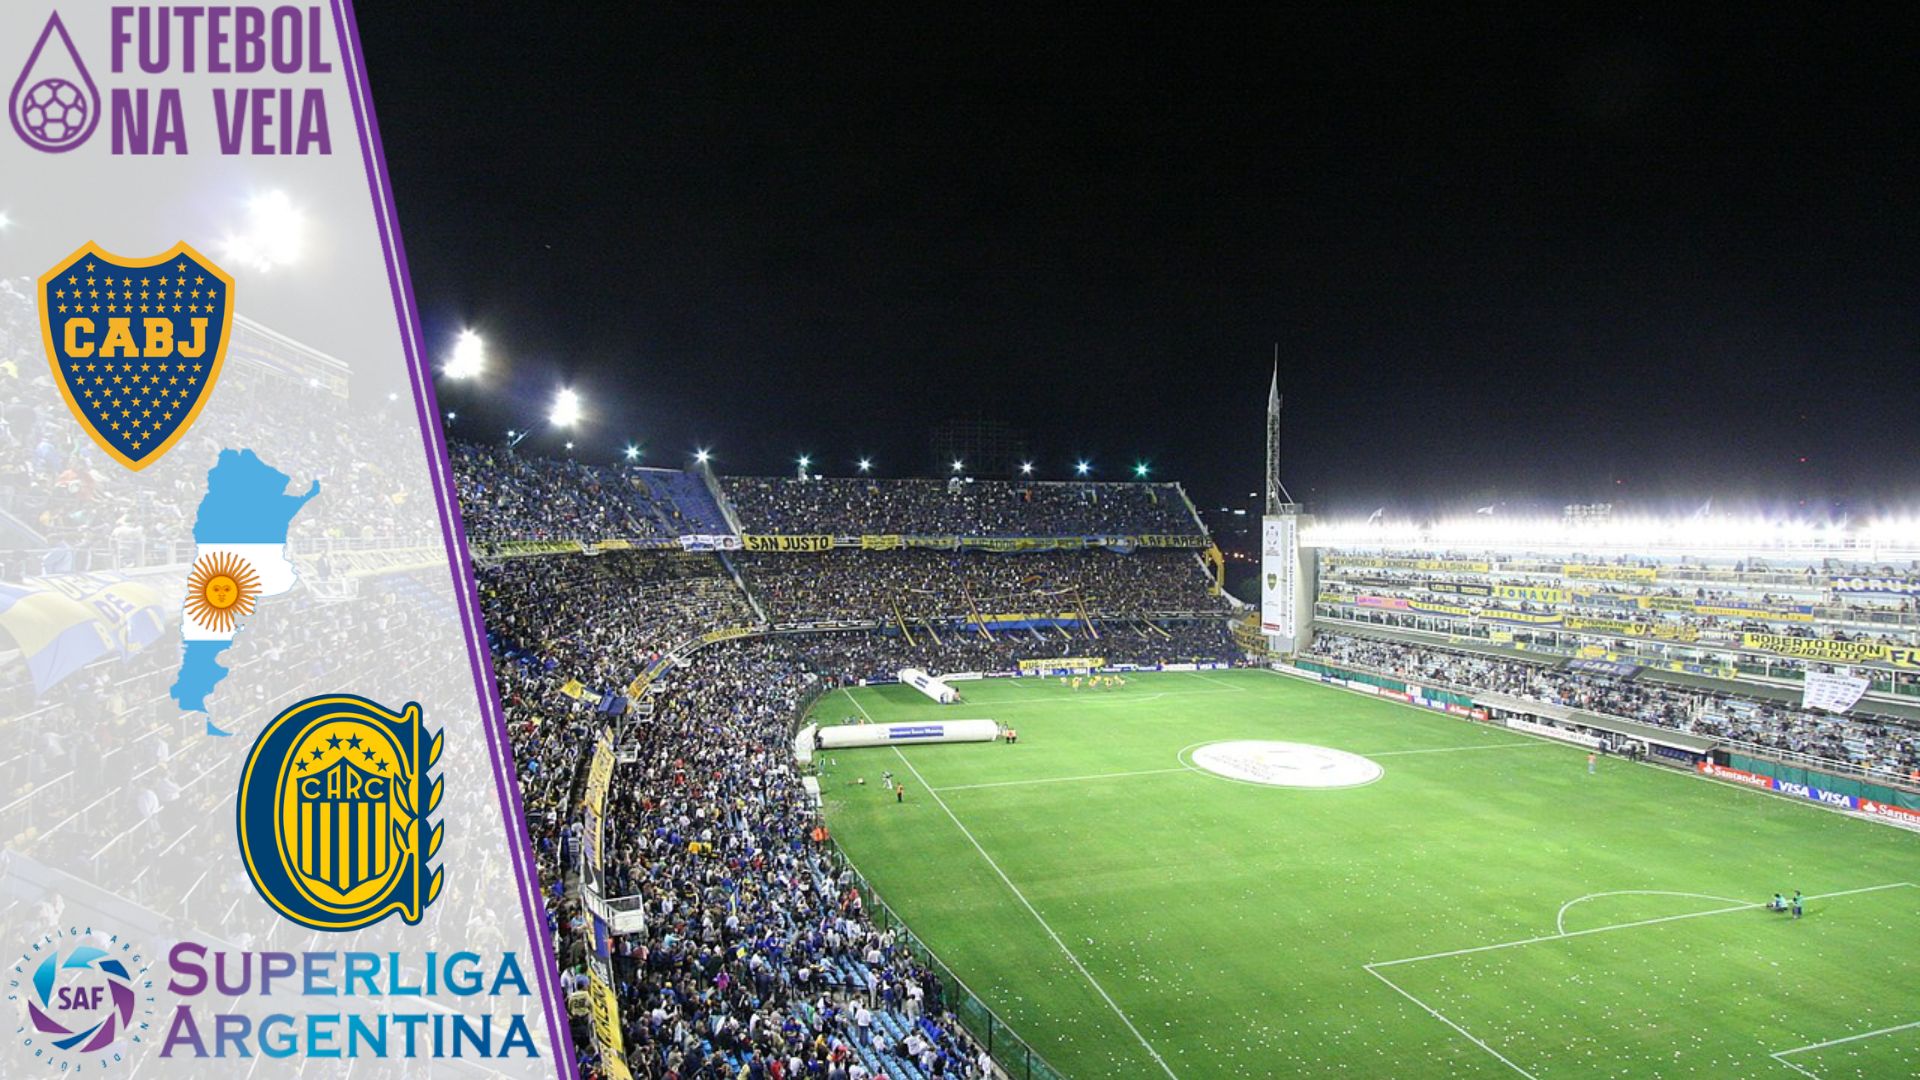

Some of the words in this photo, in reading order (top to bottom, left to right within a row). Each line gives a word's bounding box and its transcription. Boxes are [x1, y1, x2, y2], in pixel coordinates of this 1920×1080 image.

[748, 536, 779, 551] SAN
[782, 536, 830, 551] JUSTO
[1750, 634, 1825, 649] ROBERTO
[1828, 641, 1881, 655] DIGON
[1713, 766, 1767, 787] Santander
[1777, 780, 1811, 797] VISA
[1817, 790, 1851, 808] VISA
